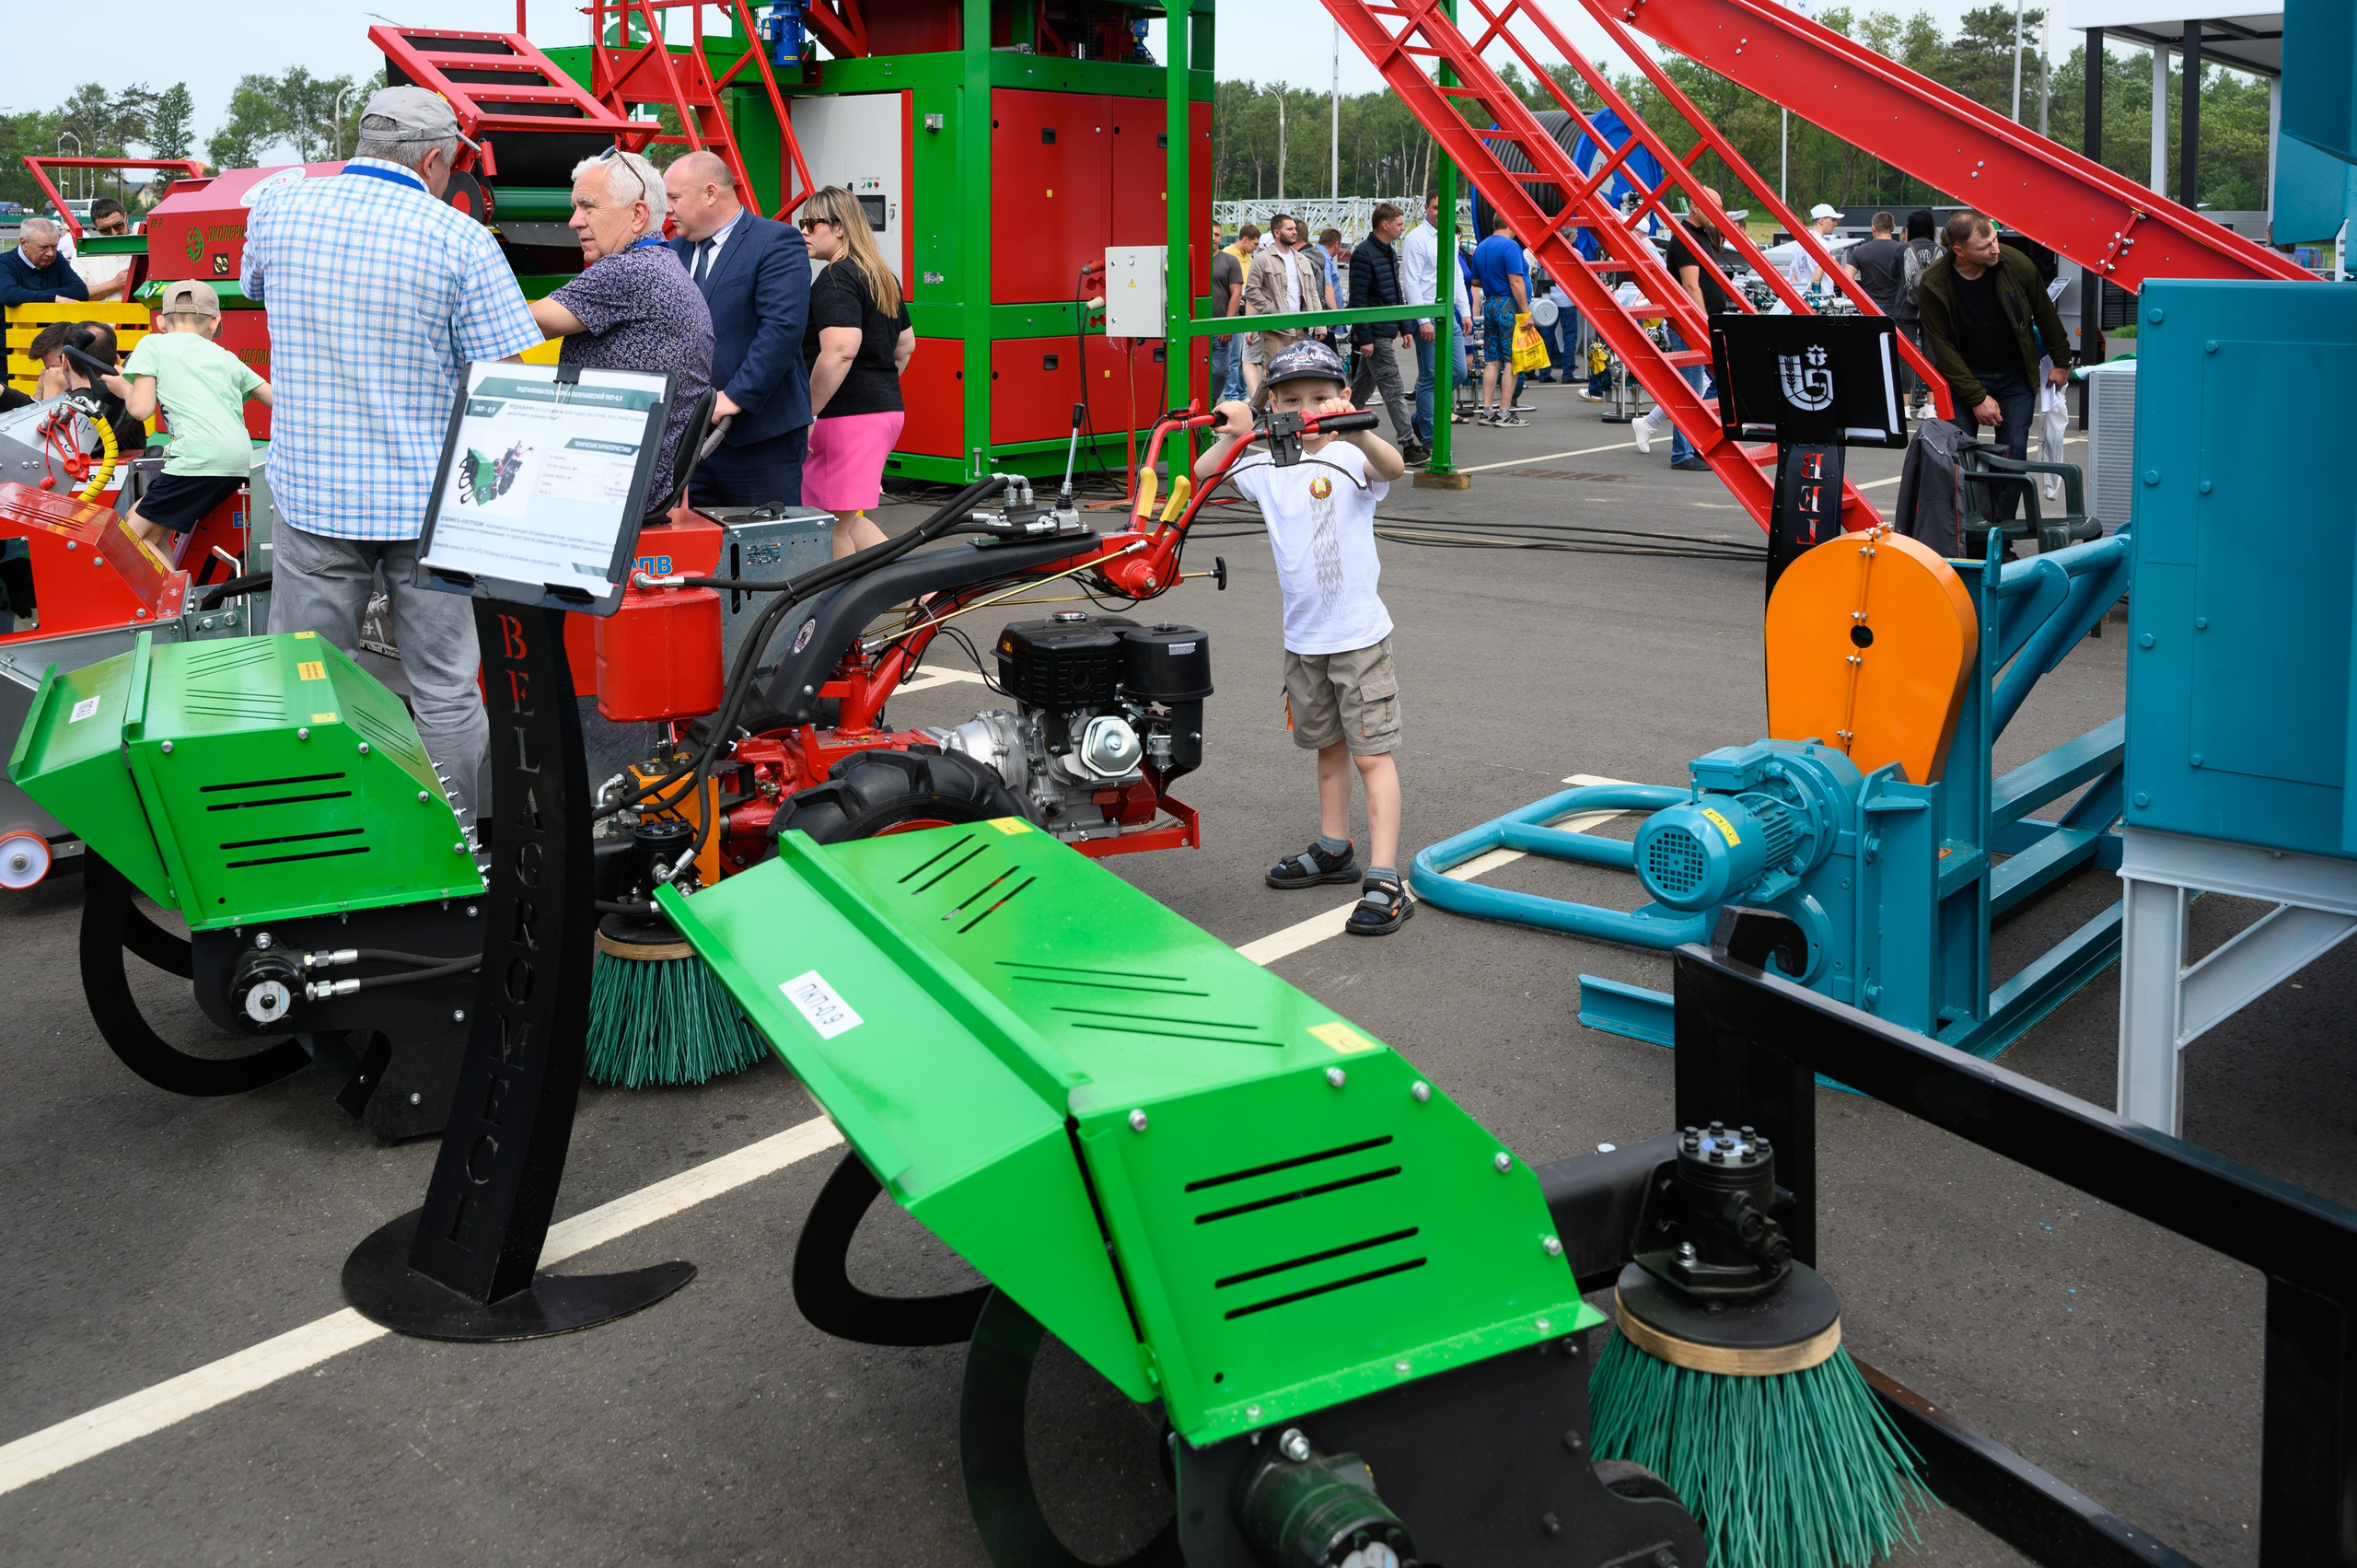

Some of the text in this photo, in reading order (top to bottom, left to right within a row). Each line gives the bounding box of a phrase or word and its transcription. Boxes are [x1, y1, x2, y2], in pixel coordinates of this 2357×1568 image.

[516, 386, 555, 396] ПОДТАЛКИВАТЕЛЬ
[473, 404, 485, 412] ПКП
[794, 982, 844, 1026] ПКП-0,9
